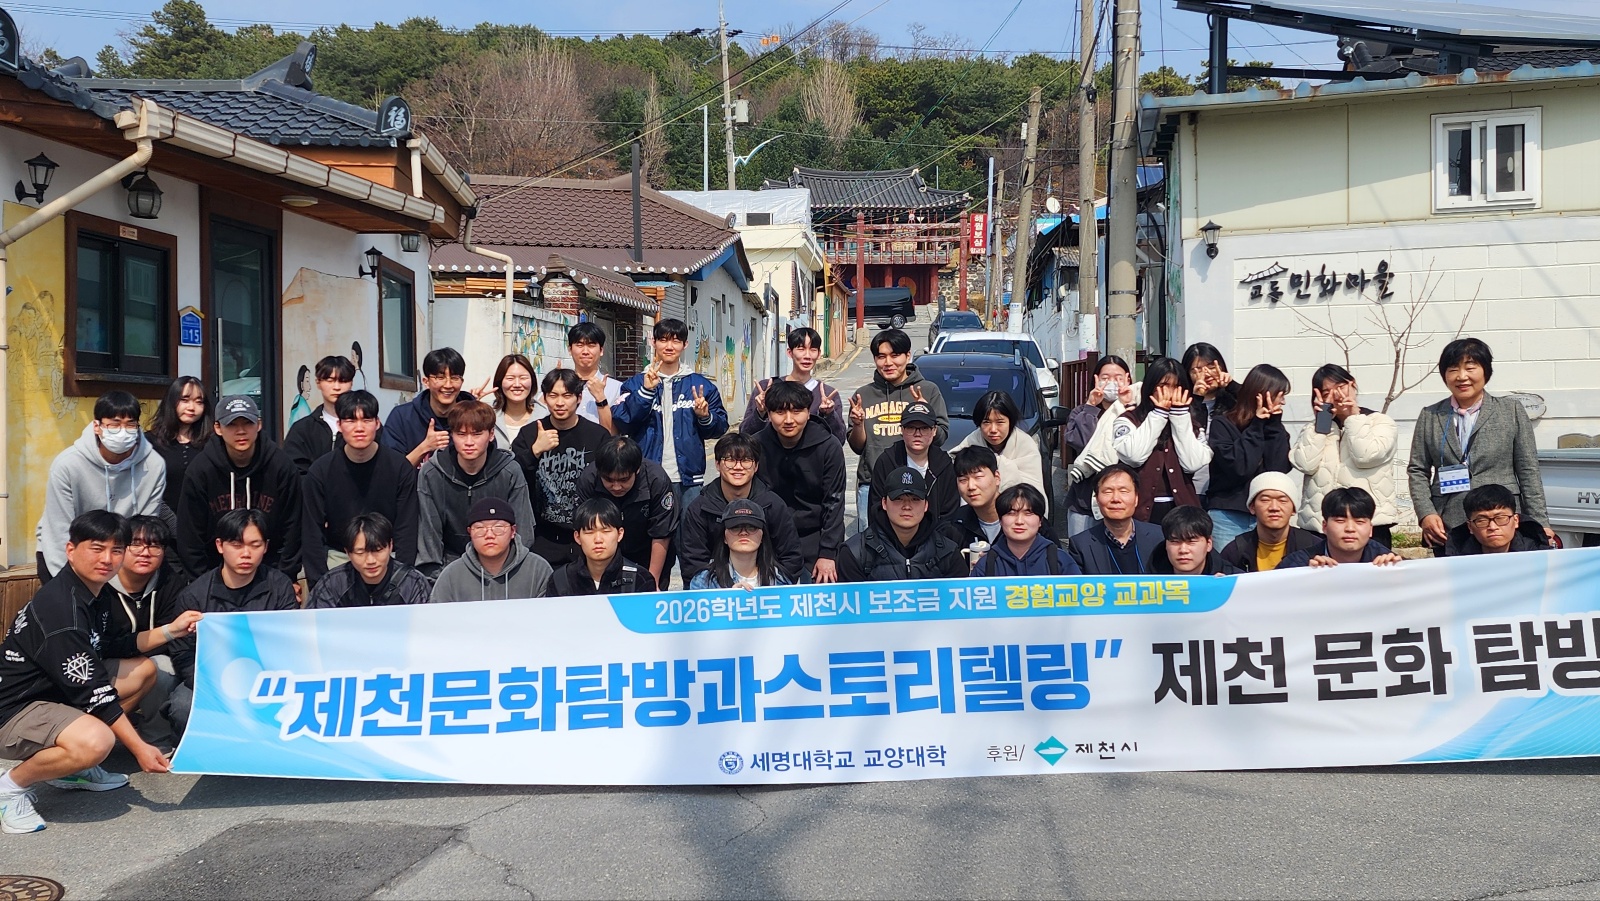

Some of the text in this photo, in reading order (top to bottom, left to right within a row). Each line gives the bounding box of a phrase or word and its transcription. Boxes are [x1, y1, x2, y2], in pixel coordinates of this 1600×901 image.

[387, 105, 407, 129] 福
[1250, 280, 1284, 304] 교동
[188, 328, 200, 343] 15
[655, 580, 1191, 626] 2026학년도 제천시 보조금 지원 경험교양 교과목
[1152, 636, 1289, 706] 제천
[1313, 626, 1453, 701] 문화
[1472, 618, 1600, 694] 탐방
[750, 750, 855, 772] 세명대학교
[864, 745, 947, 768] 교양대학
[1074, 740, 1138, 760] 제천시
